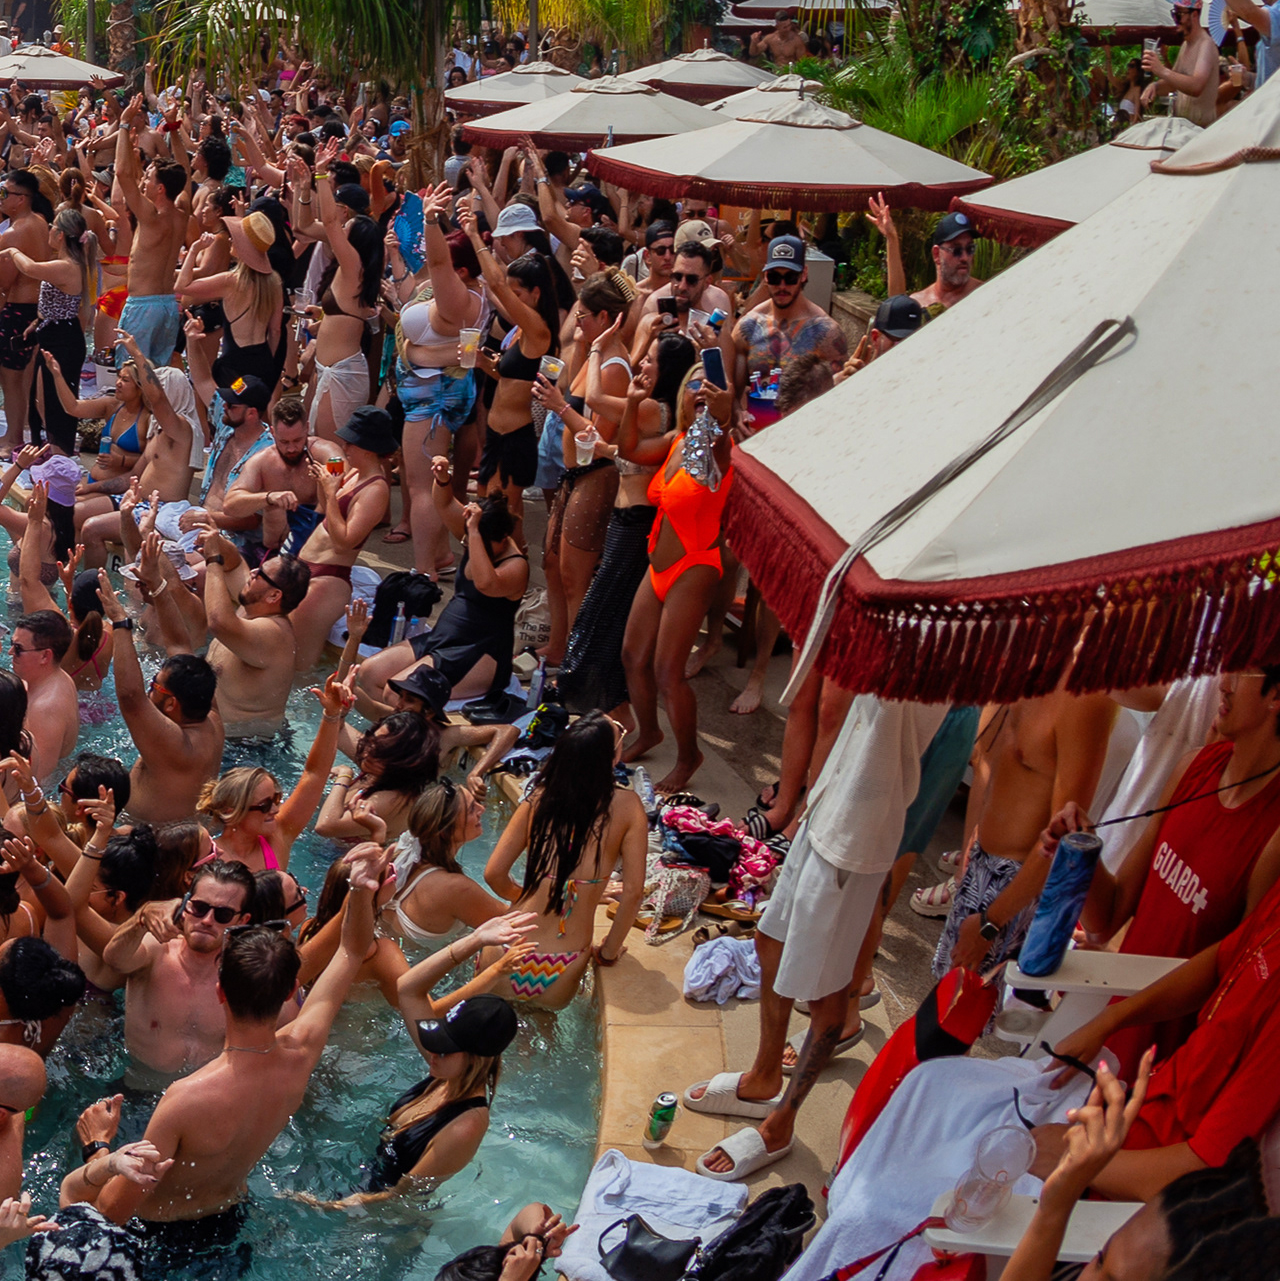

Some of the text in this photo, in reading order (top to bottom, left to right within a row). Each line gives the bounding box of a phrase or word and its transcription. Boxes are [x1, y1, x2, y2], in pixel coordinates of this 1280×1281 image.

[112, 554, 122, 573] 6
[522, 621, 538, 632] The
[519, 631, 536, 642] The
[1153, 841, 1200, 905] GUARD
